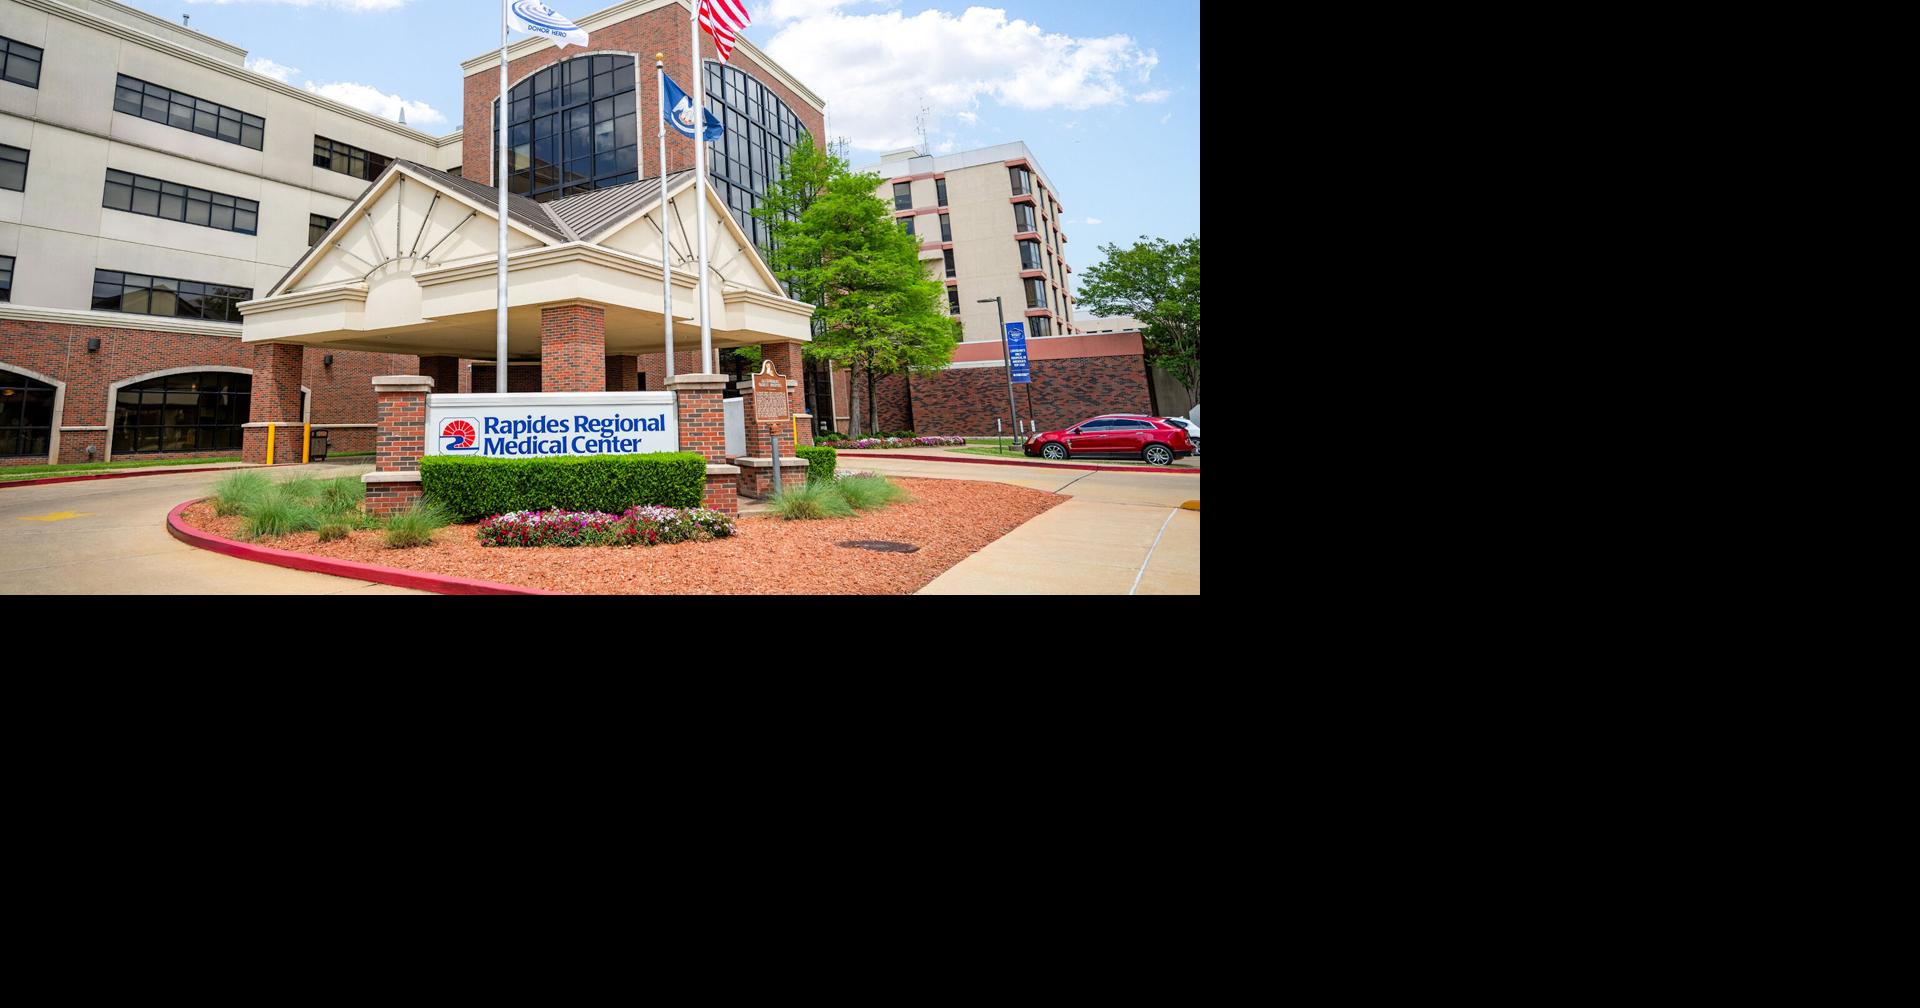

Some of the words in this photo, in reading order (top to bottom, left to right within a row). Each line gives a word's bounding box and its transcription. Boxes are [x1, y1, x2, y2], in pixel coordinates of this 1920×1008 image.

[528, 25, 550, 34] DONOR
[484, 415, 569, 438] Rapides
[574, 414, 665, 437] Regional
[484, 436, 567, 455] Medical
[572, 436, 642, 453] Center
